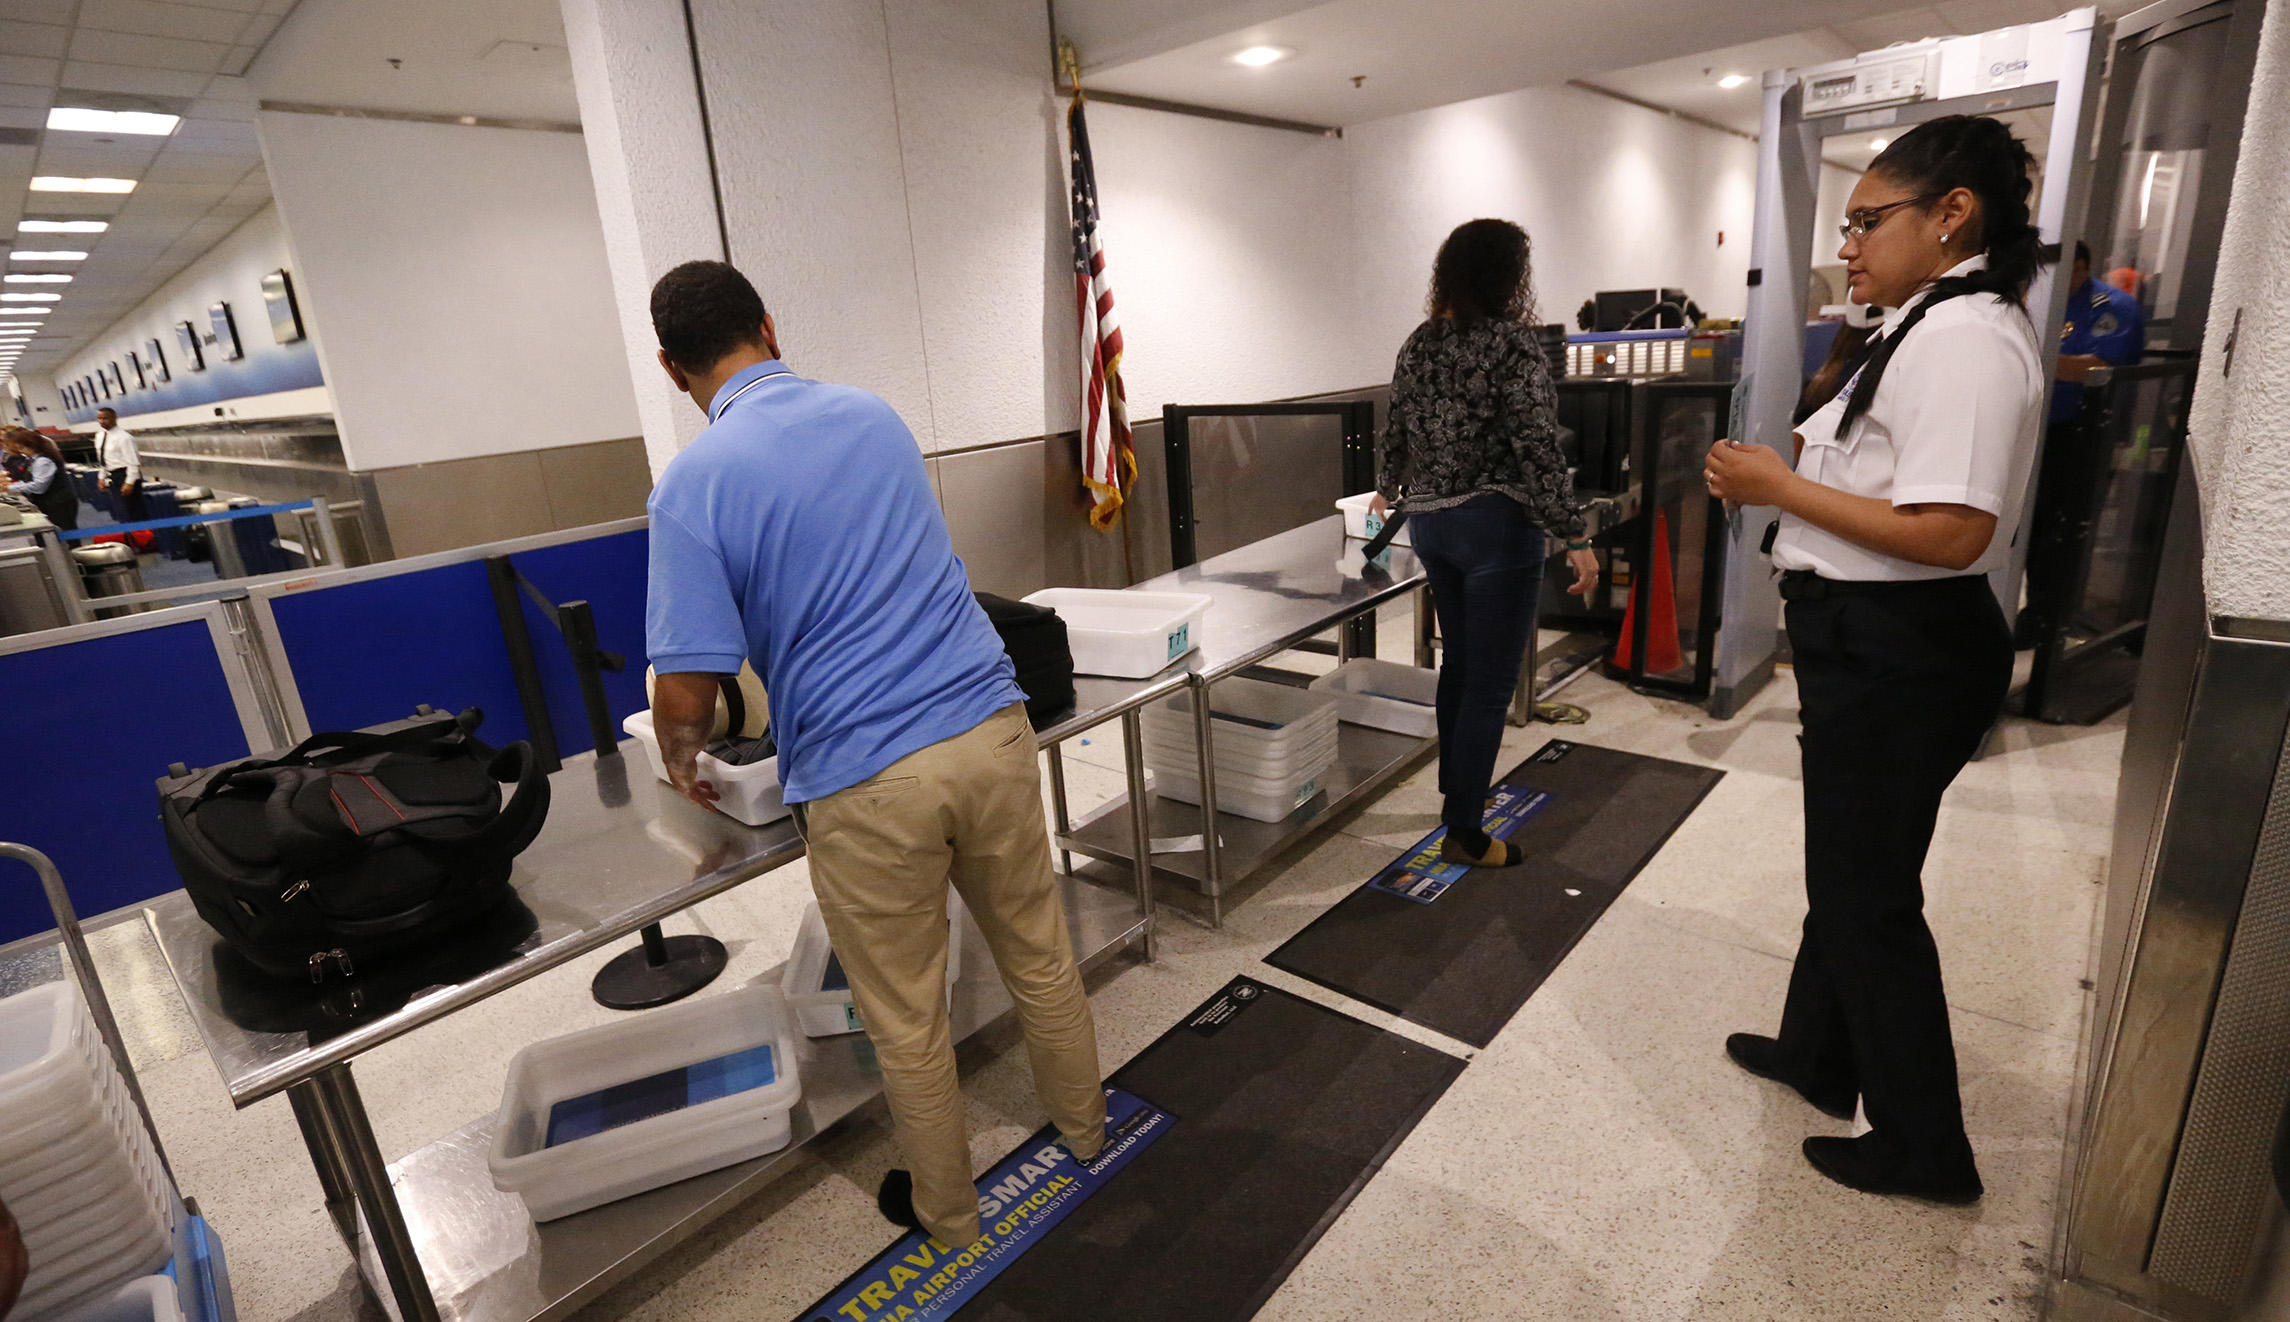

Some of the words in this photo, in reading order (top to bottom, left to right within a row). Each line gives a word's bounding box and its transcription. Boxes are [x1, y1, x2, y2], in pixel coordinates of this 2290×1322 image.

[1404, 834, 1446, 870] TRAV
[1089, 1136, 1137, 1175] DOWNLOAD
[1134, 1113, 1164, 1137] TODAY!
[913, 1233, 996, 1307] AIRPORT
[994, 1174, 1074, 1236] OFFICIAL
[921, 1262, 987, 1318] PERSONAL
[984, 1228, 1030, 1262] TRAVEL
[1028, 1180, 1082, 1228] ASSISTANT
